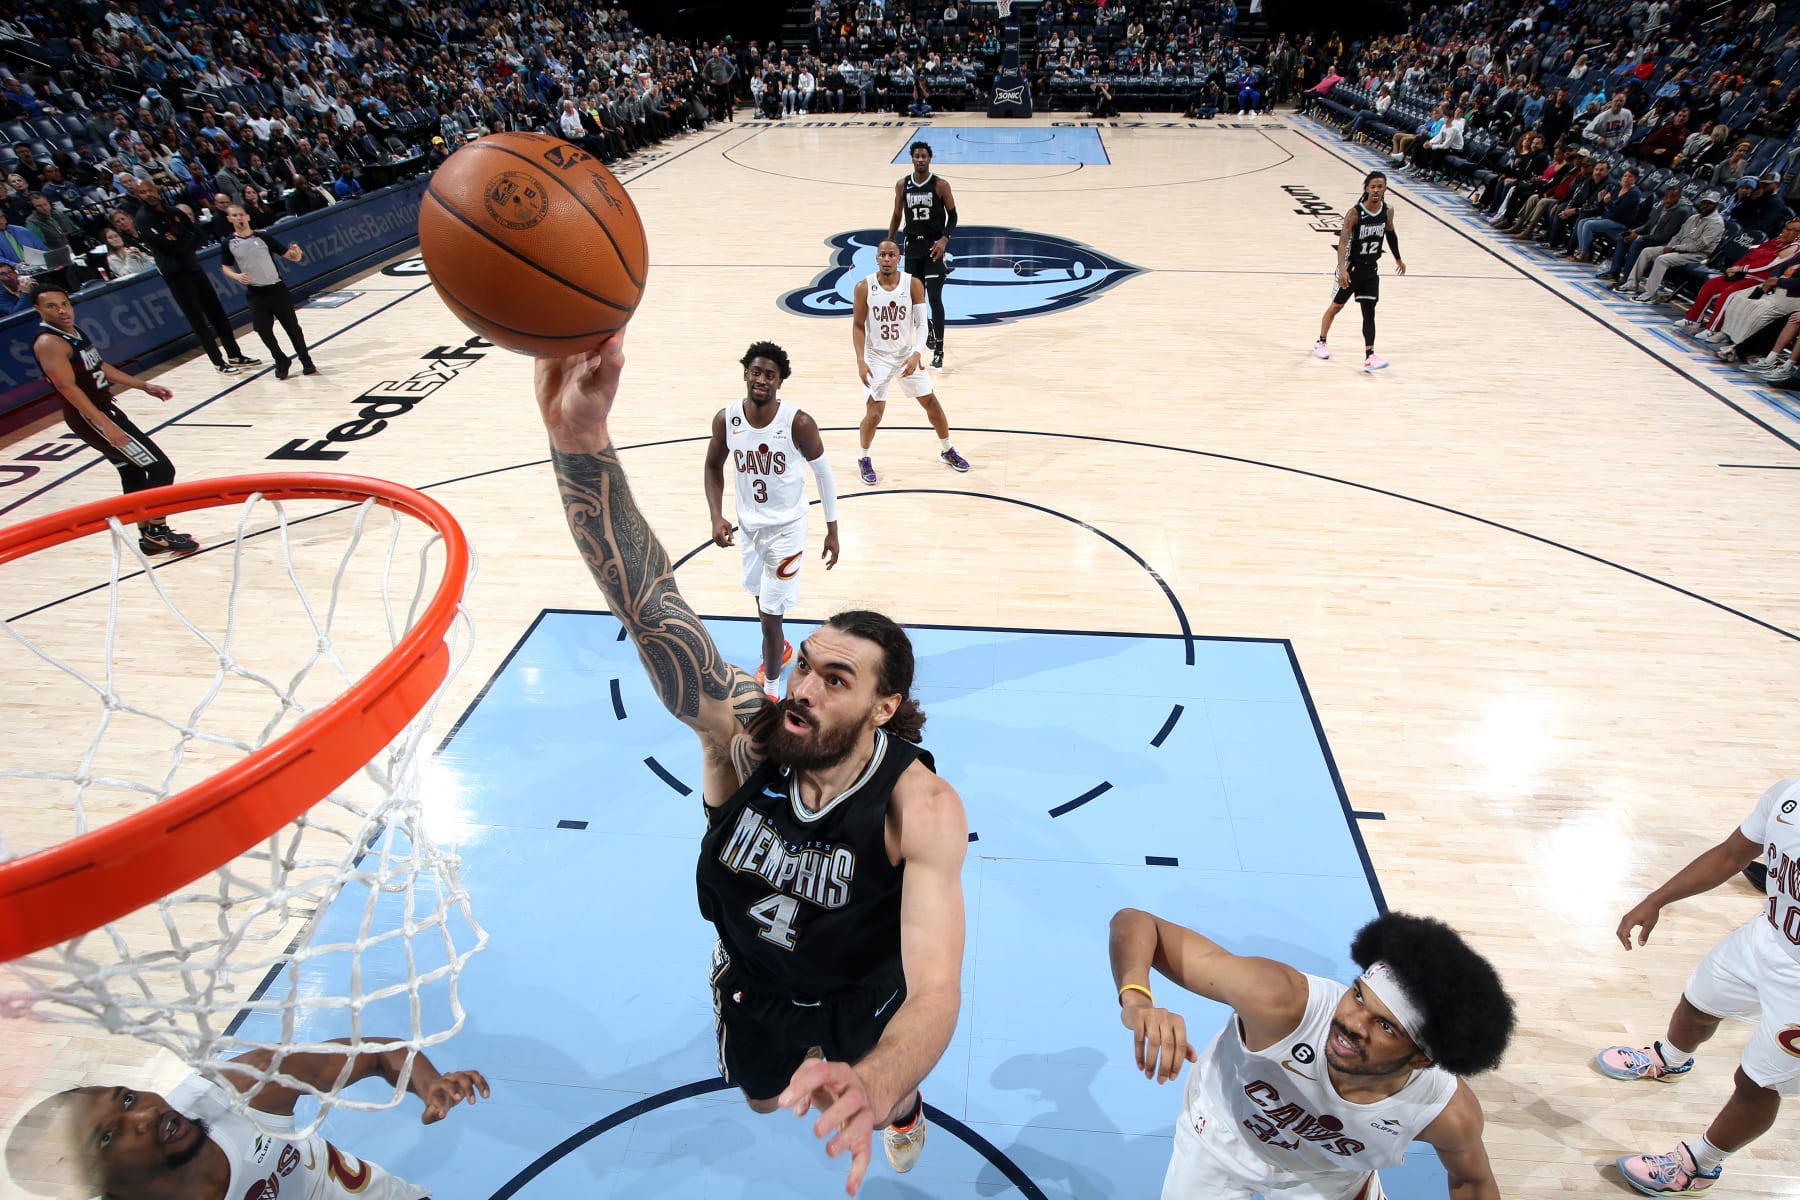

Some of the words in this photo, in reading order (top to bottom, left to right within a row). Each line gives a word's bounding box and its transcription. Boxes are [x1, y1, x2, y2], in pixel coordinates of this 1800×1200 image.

[997, 92, 1020, 100] SONIC
[906, 192, 933, 208] MEMPHIS
[911, 207, 930, 221] 13
[1358, 222, 1386, 240] MEMPHIS
[1359, 241, 1380, 255] 12
[872, 305, 907, 322] CAVS
[880, 324, 899, 341] 35
[734, 448, 786, 475] CAVS
[752, 479, 768, 504] 3
[1782, 800, 1797, 814] 6
[719, 803, 856, 910] MEMPHIS
[746, 892, 800, 952] 4
[1293, 1045, 1313, 1062] 6
[1244, 1079, 1366, 1156] CAVS
[1370, 1122, 1399, 1136] CLIFFS
[257, 1137, 272, 1164] CLIFF
